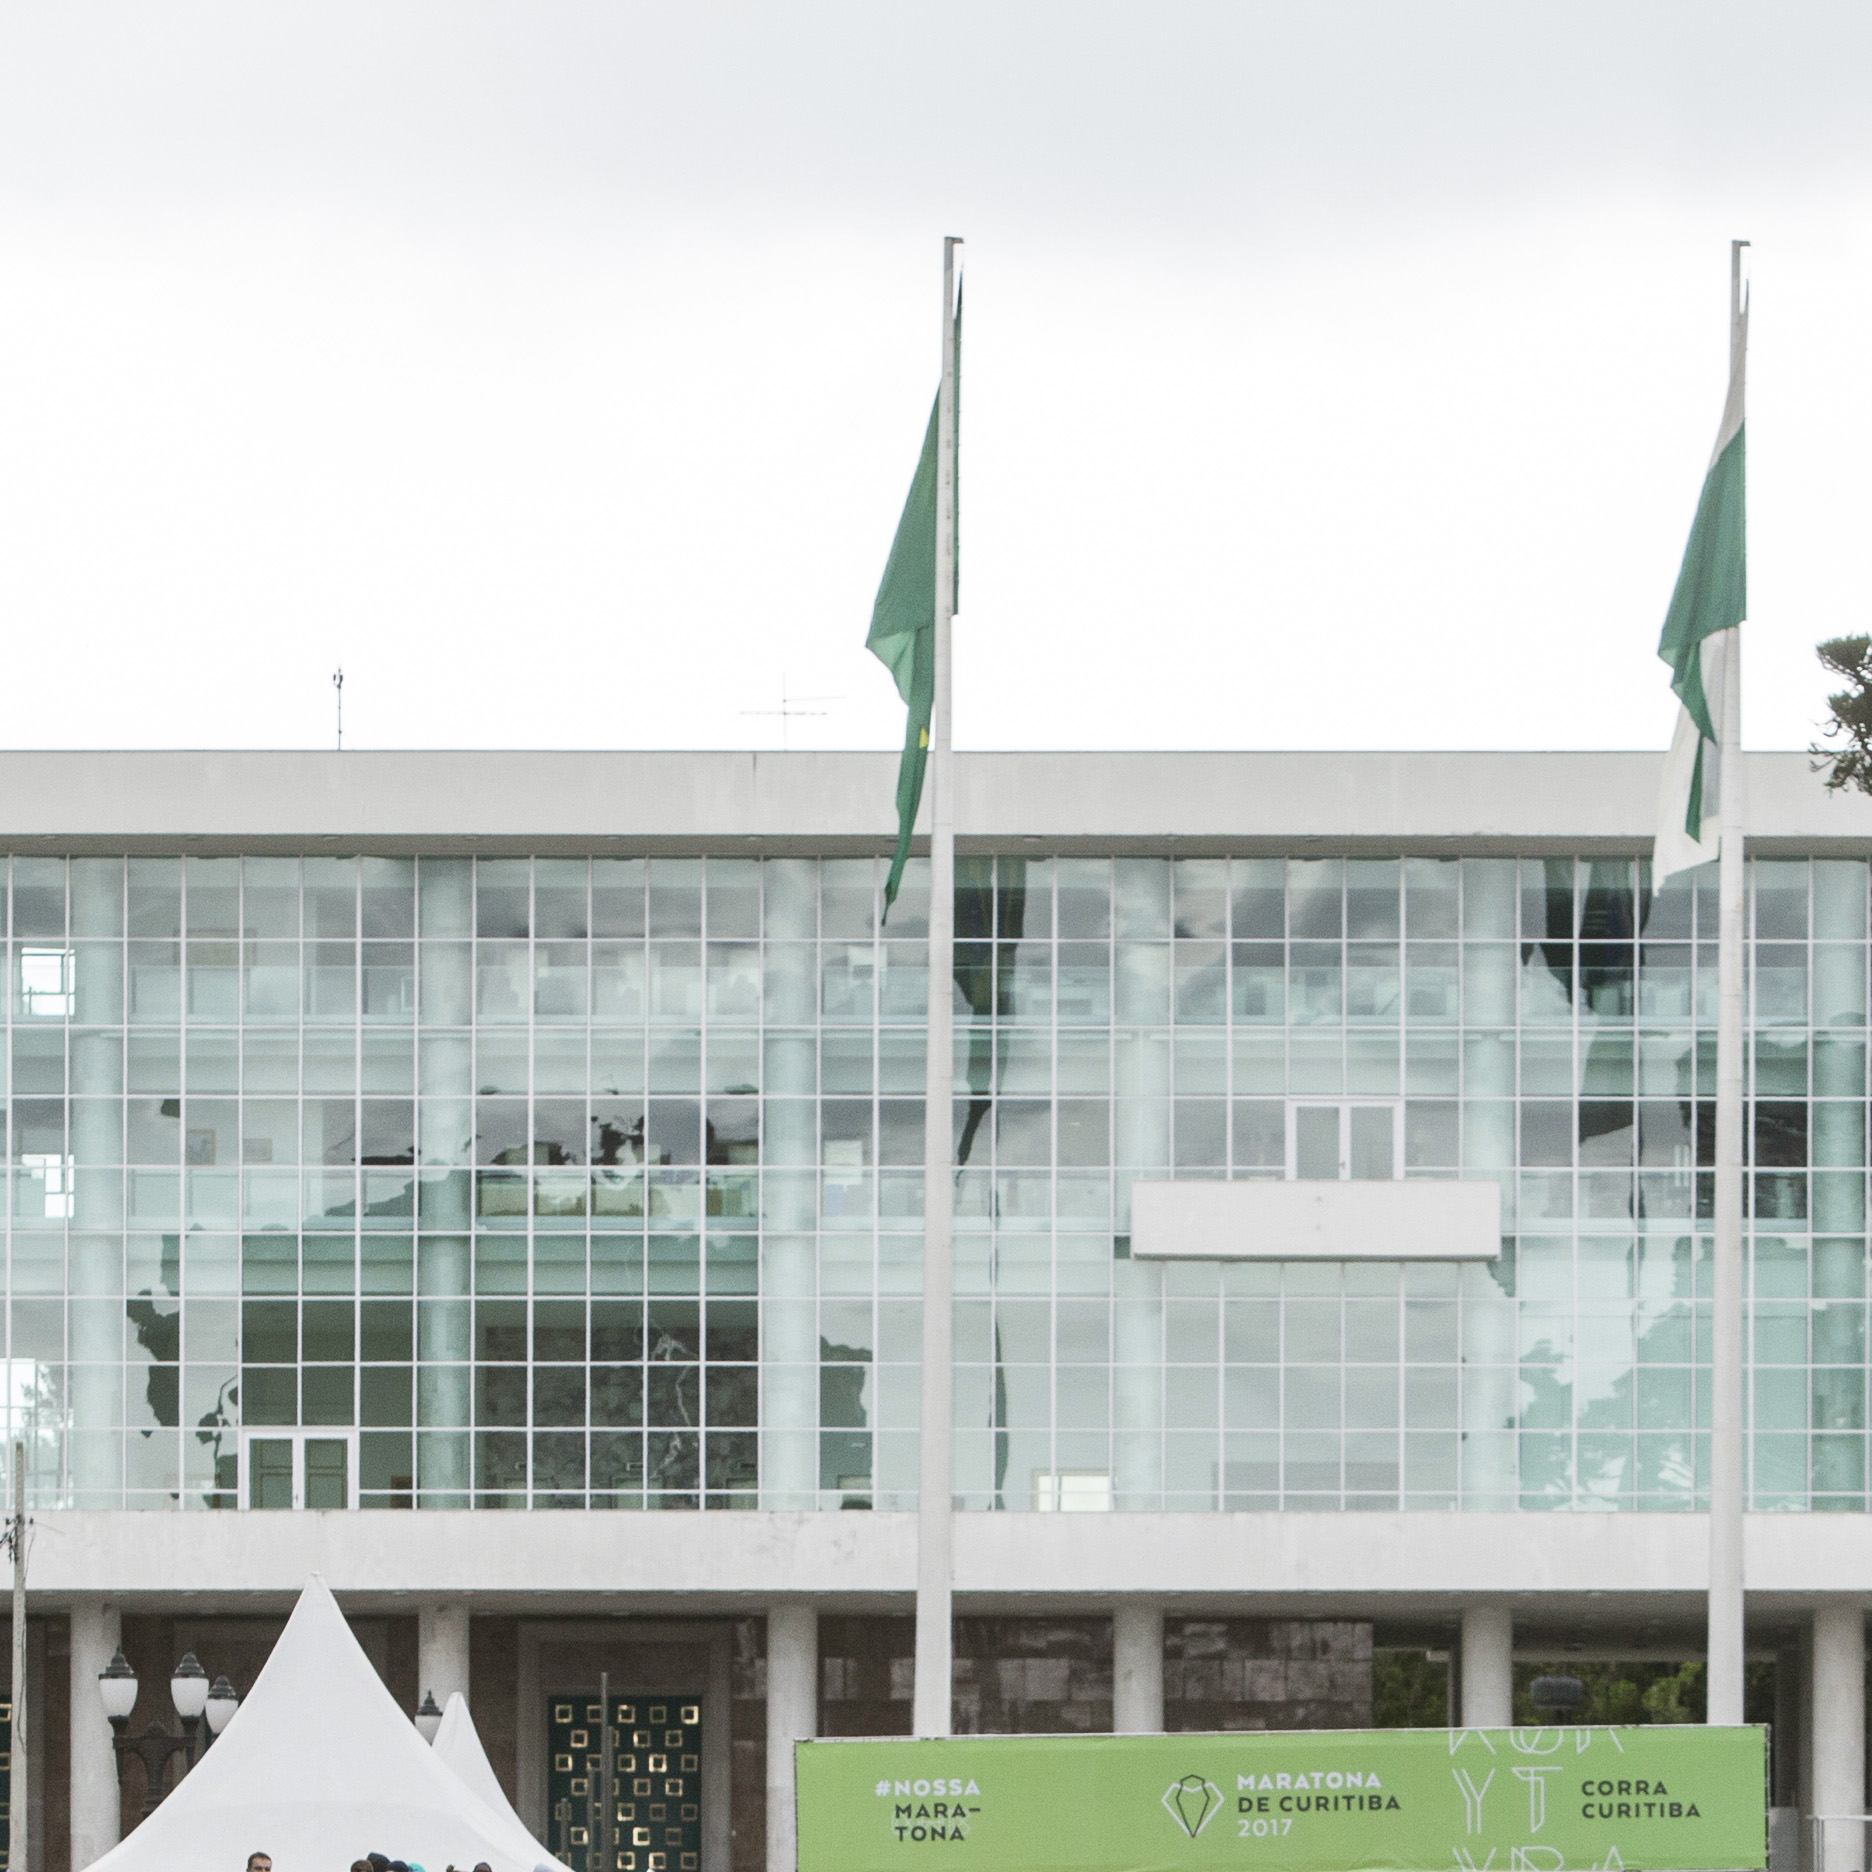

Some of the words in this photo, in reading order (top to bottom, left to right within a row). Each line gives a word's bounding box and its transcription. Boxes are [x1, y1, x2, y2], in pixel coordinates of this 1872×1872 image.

[875, 1779, 981, 1797] #NOSSA
[1237, 1772, 1382, 1791] MARATONA
[1581, 1780, 1668, 1796] CORRA
[895, 1803, 981, 1819] MARA-
[1238, 1796, 1270, 1813] DE
[1279, 1795, 1401, 1812] CURITIBA
[1581, 1803, 1701, 1818] CURITIBA
[895, 1826, 965, 1842] TONA
[1238, 1819, 1293, 1837] 2017
